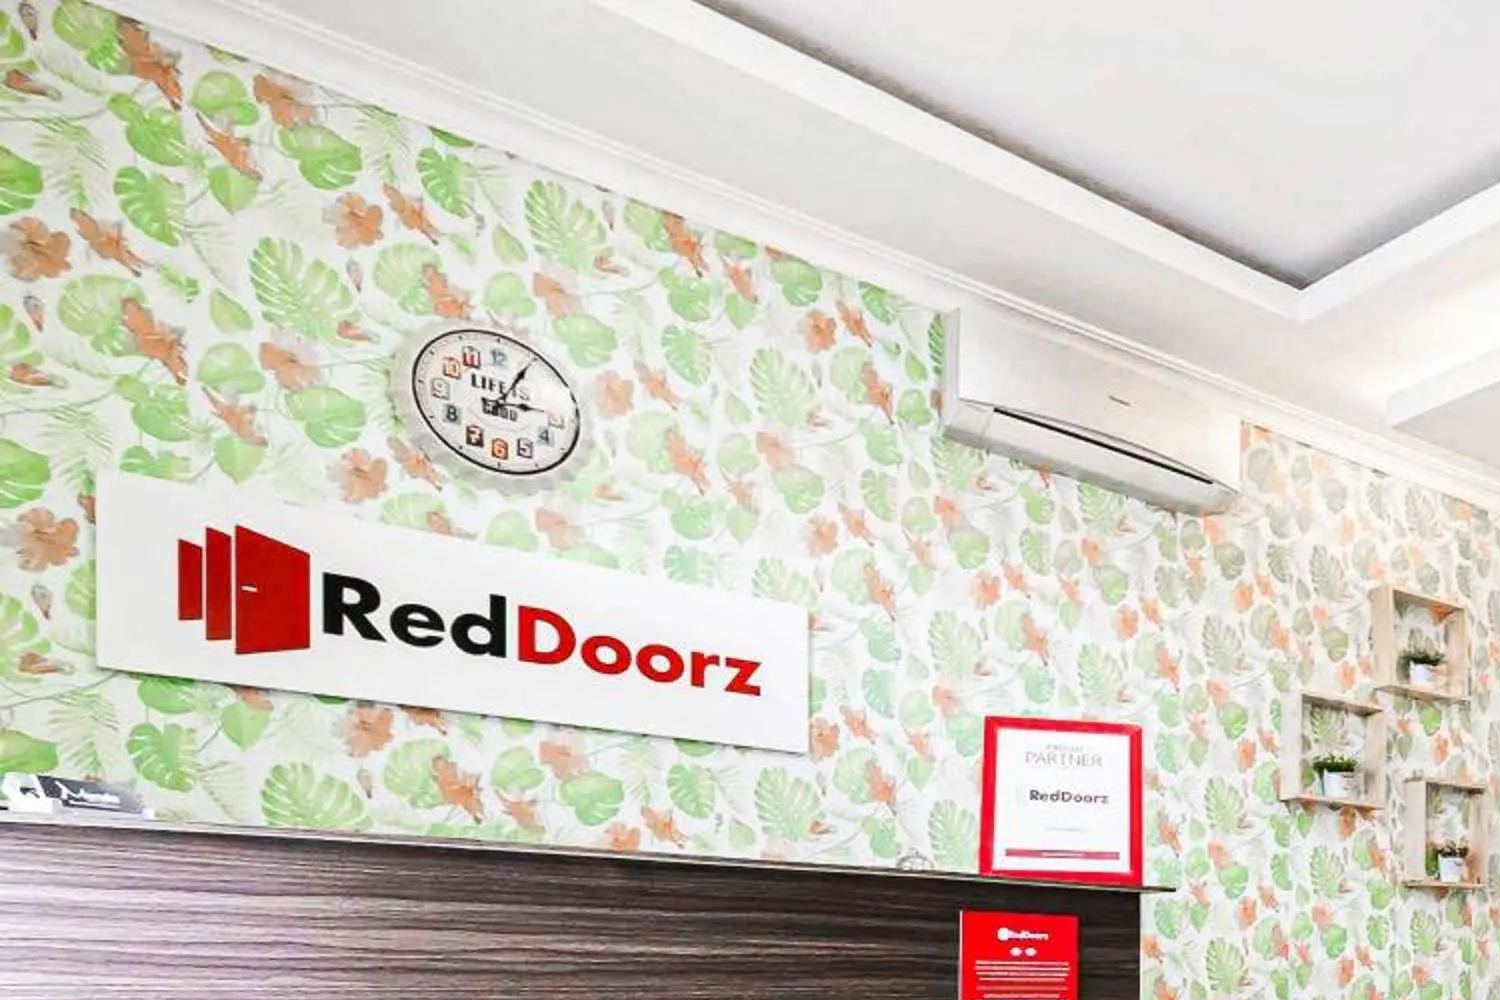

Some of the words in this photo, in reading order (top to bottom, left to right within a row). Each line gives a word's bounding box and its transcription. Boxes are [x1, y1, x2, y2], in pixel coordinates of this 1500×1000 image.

[322, 571, 762, 697] RedDoorz
[1025, 751, 1103, 767] PARTNER
[1029, 789, 1108, 804] RedDoorz
